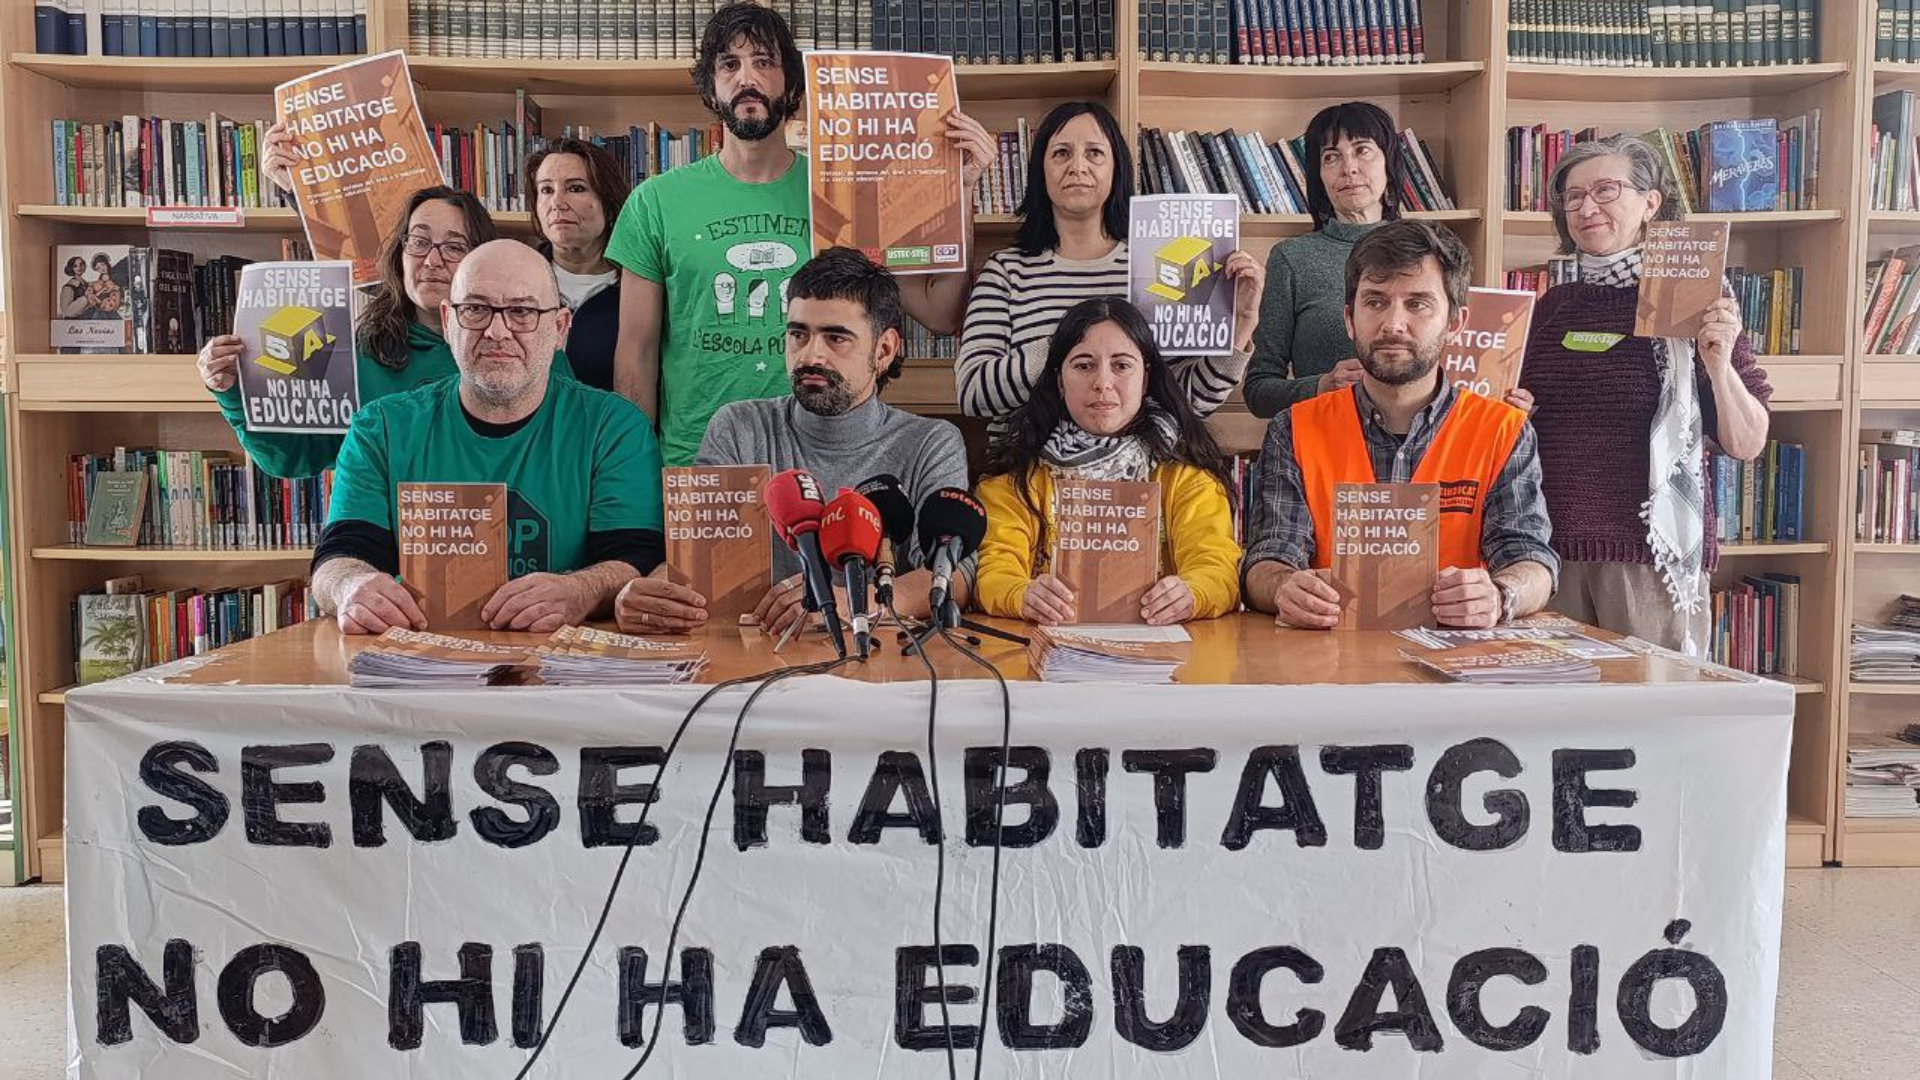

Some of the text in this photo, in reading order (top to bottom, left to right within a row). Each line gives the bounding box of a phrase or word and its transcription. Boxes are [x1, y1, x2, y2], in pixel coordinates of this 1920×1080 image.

[816, 67, 889, 85] SENSE
[283, 83, 345, 114] SENSE
[818, 92, 939, 110] HABITATGE
[285, 96, 398, 136] HABITATGE
[819, 117, 916, 136] NO HI HA
[291, 127, 383, 160] NO HI HA
[820, 137, 934, 162] EDUCACIÓ
[300, 142, 407, 186] EDUCACIÓ
[1158, 201, 1213, 219] SENSE
[1135, 219, 1234, 238] HABITATGE
[1649, 227, 1691, 237] SENSE
[935, 248, 957, 256] CGT
[1647, 241, 1718, 252] HABITATGE
[1646, 254, 1701, 265] NO HI HA
[264, 269, 321, 288] SENSE
[1645, 267, 1710, 279] EDUCACIÓ
[241, 288, 346, 308] HABITATGE
[1154, 304, 1211, 323] NO HI HA
[1149, 317, 1229, 348] DUCACIÓ
[1445, 354, 1477, 373] HA
[267, 378, 331, 398] NO HI HA
[250, 392, 353, 425] EDUCACIÓ
[666, 474, 721, 488] SENSE
[401, 491, 455, 503] SENSE
[667, 490, 757, 505] HABITATGE
[1061, 488, 1112, 500] SENSE
[1337, 491, 1391, 503] SENSE
[401, 508, 492, 521] HABITATGE
[668, 508, 739, 522] NO HI HA
[1061, 505, 1146, 518] HABITATGE
[1337, 509, 1427, 521] HABITATGE
[402, 526, 474, 538] NO HI HA
[668, 523, 752, 540] EDUCACIÓ
[1061, 522, 1128, 535] NO HI HA
[1336, 526, 1407, 538] NO HI HA
[402, 540, 487, 555] EDUCACIÓ
[1060, 538, 1139, 552] EDUCACIÓ
[1336, 540, 1420, 555] EDUCACIÓ
[136, 737, 1642, 851] SENSE HABITATGE
[96, 918, 1728, 1059] NO HI HA EDUCACIÓ
